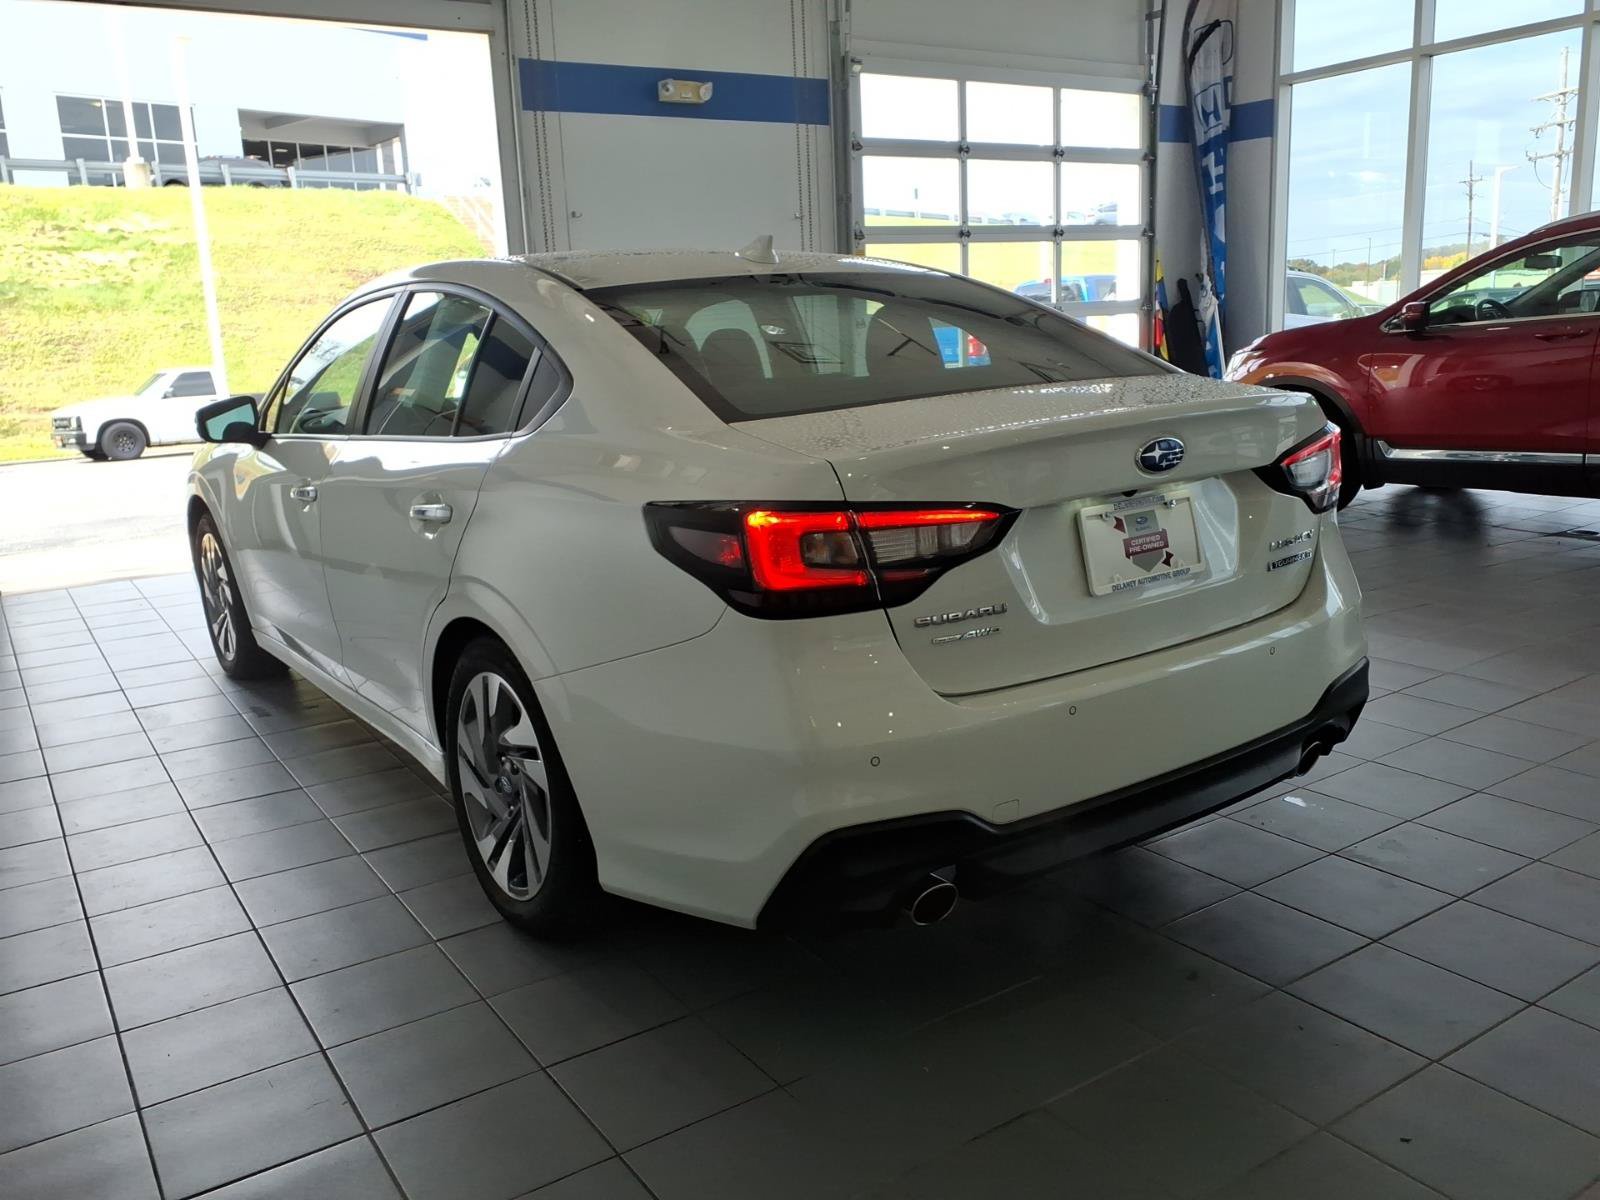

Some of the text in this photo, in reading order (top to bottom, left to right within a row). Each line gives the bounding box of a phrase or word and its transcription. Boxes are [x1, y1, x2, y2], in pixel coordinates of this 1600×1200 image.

[1129, 541, 1165, 553] PRE-OWNED
[1130, 534, 1161, 546] CERTIFIED
[1111, 567, 1191, 592] DELANEY AUTOMOTIVE GROUP
[914, 602, 1008, 628] SUBARU
